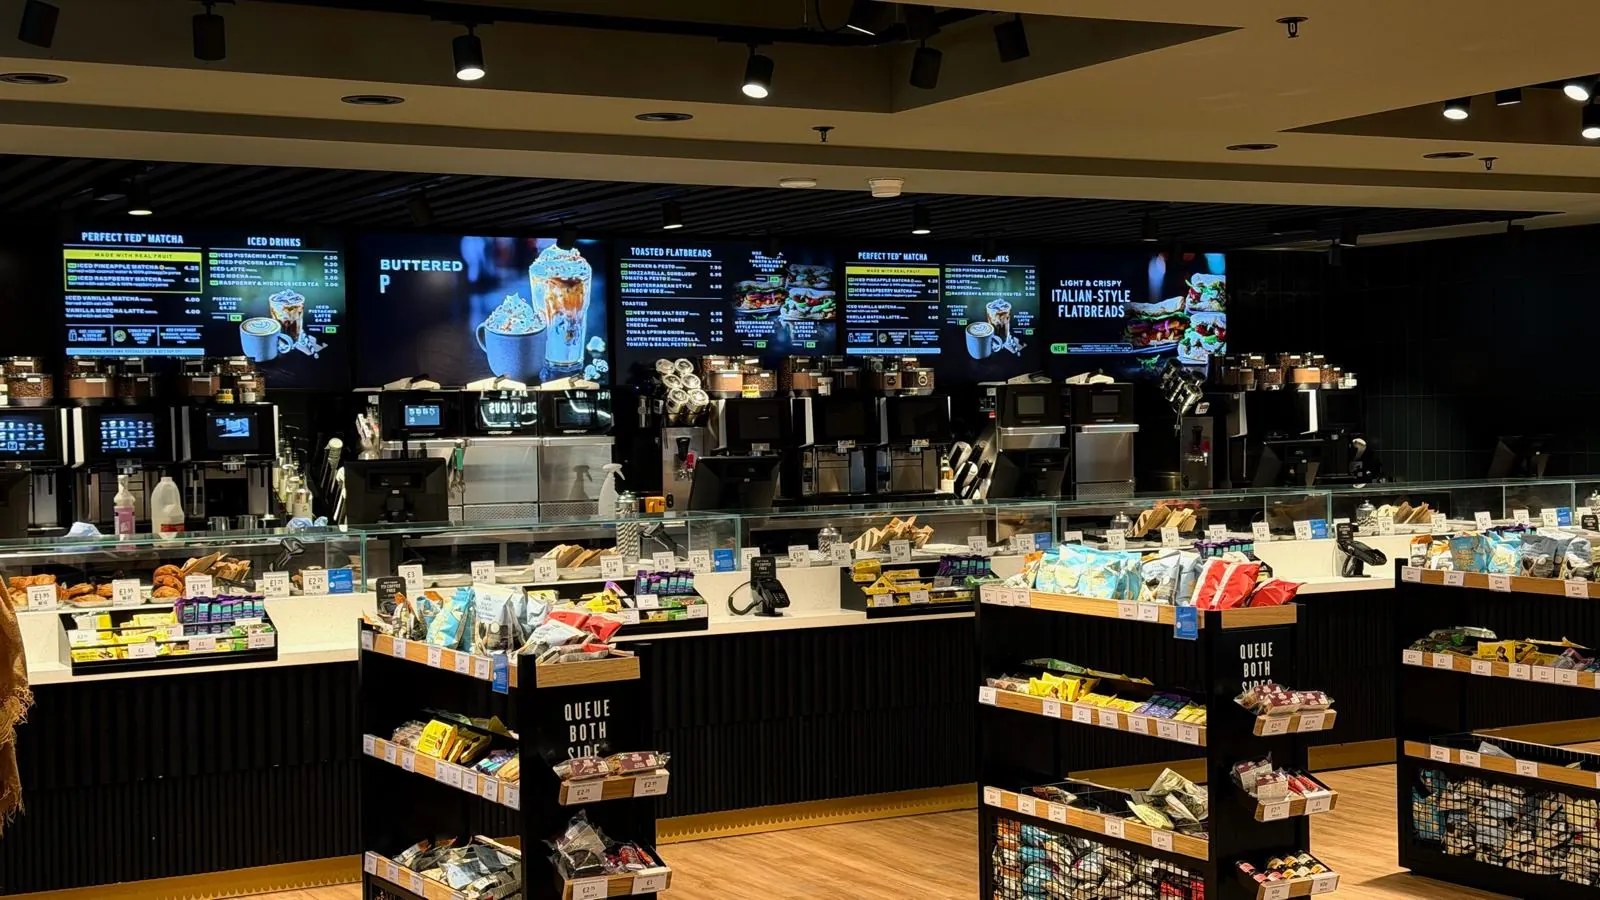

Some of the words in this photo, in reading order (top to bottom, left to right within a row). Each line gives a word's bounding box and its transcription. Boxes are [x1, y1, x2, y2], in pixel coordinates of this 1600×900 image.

[82, 232, 122, 242] PERFECT
[148, 234, 184, 244] MATCHA
[247, 237, 267, 246] ICED
[269, 238, 301, 247] DRINKS
[631, 247, 664, 257] TOASTED
[665, 248, 712, 258] FLATBREADS
[858, 252, 885, 260] PERFECT
[903, 253, 928, 261] MATCHA
[380, 259, 463, 272] BUTTERED
[380, 274, 390, 293] P
[1060, 279, 1084, 287] LIGHT
[1051, 289, 1131, 303] ITALIAN-STYLE
[1058, 304, 1125, 318] FLATBREADS
[1240, 642, 1273, 660] QUEUE
[1243, 660, 1271, 678] BOTH
[564, 699, 611, 721] QUEUE
[569, 721, 607, 743] BOTH
